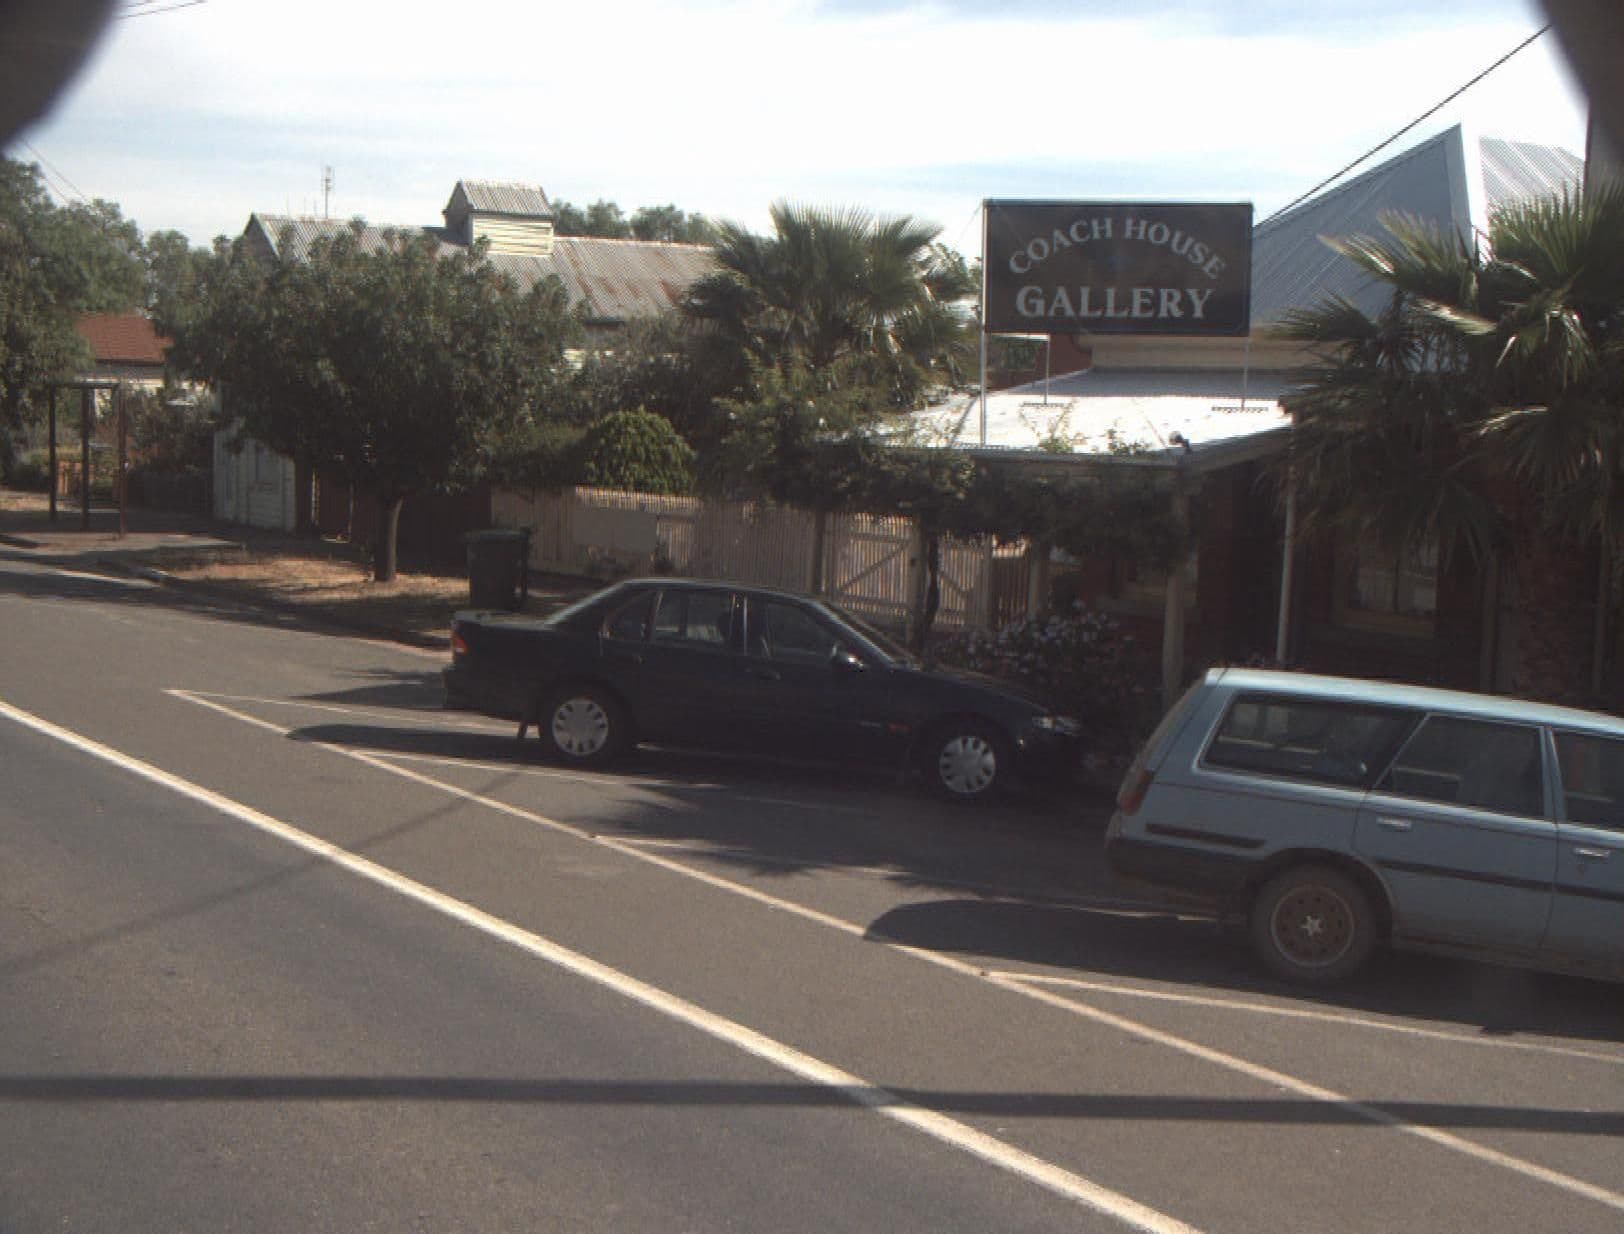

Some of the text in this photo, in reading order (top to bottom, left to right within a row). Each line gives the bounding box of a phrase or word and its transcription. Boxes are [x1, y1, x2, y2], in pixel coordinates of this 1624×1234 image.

[1010, 217, 1226, 280] COACH HOUSE
[1016, 285, 1214, 319] GALLERY
